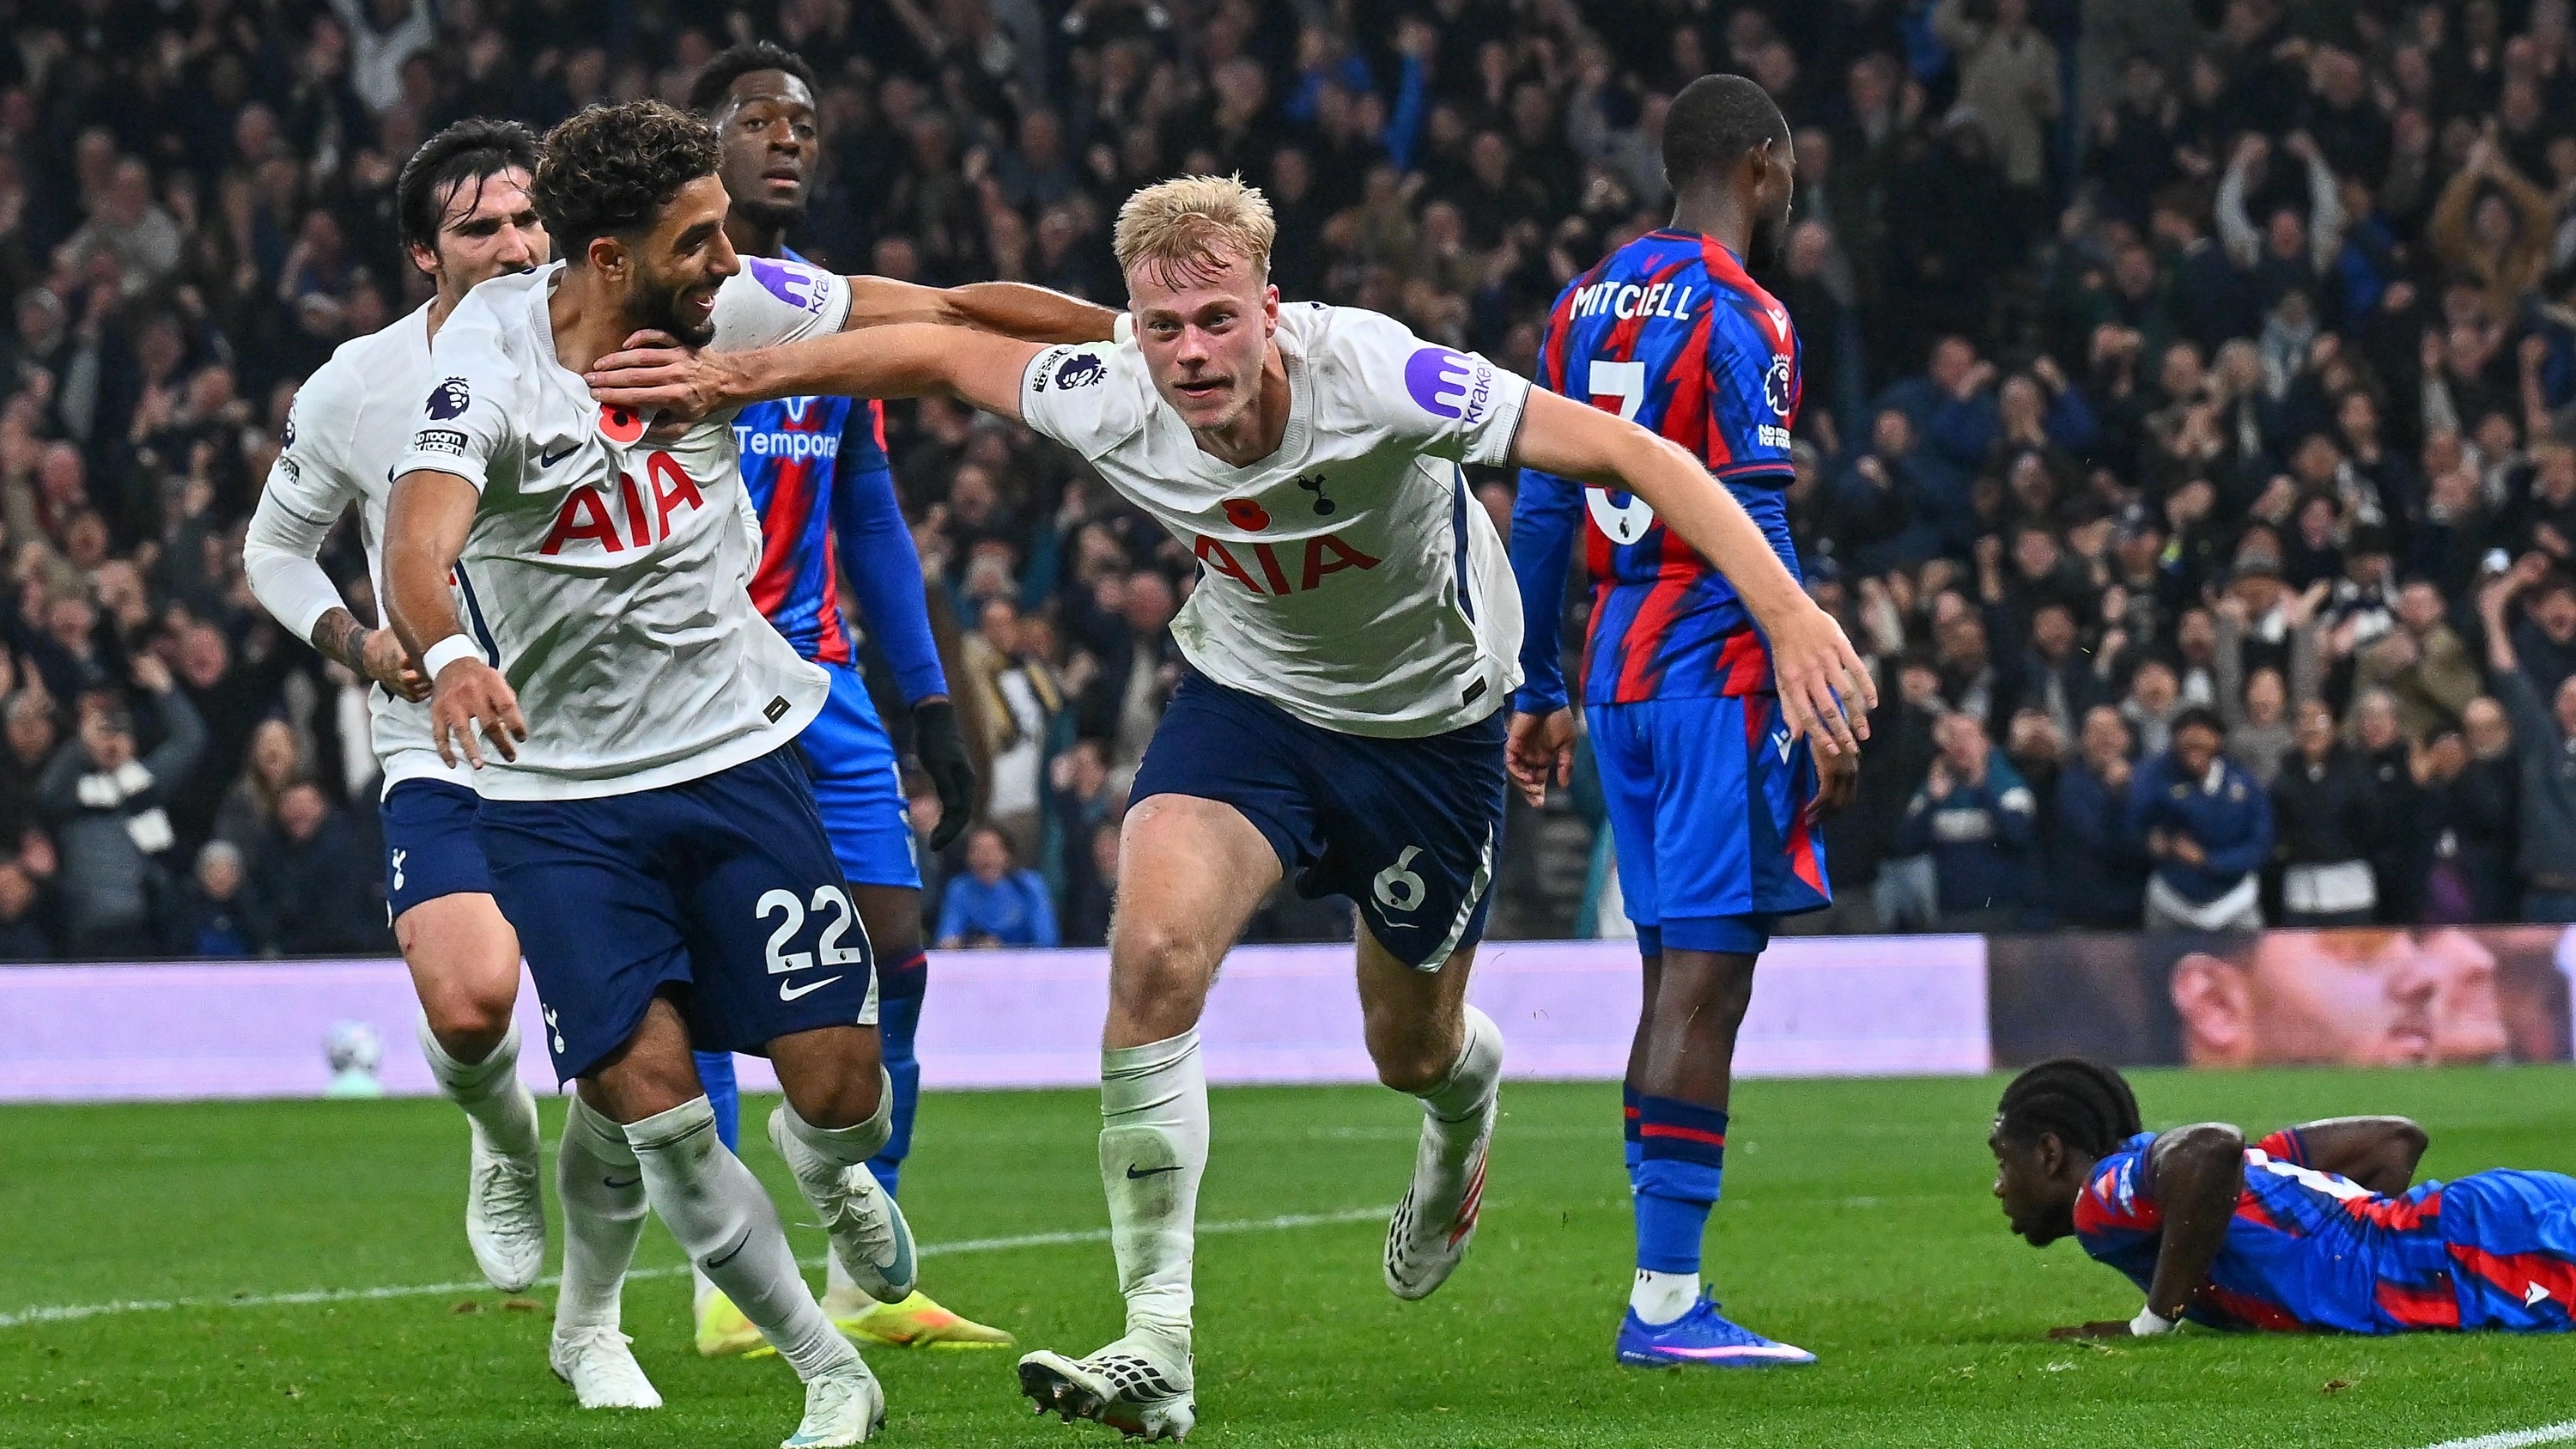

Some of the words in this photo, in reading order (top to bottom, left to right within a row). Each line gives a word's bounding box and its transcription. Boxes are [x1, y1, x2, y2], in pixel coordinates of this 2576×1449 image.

[426, 432, 462, 445] room
[540, 450, 704, 555] AIA
[1194, 534, 1382, 595] AIA
[1374, 845, 1425, 911] 6
[756, 885, 862, 974] 22
